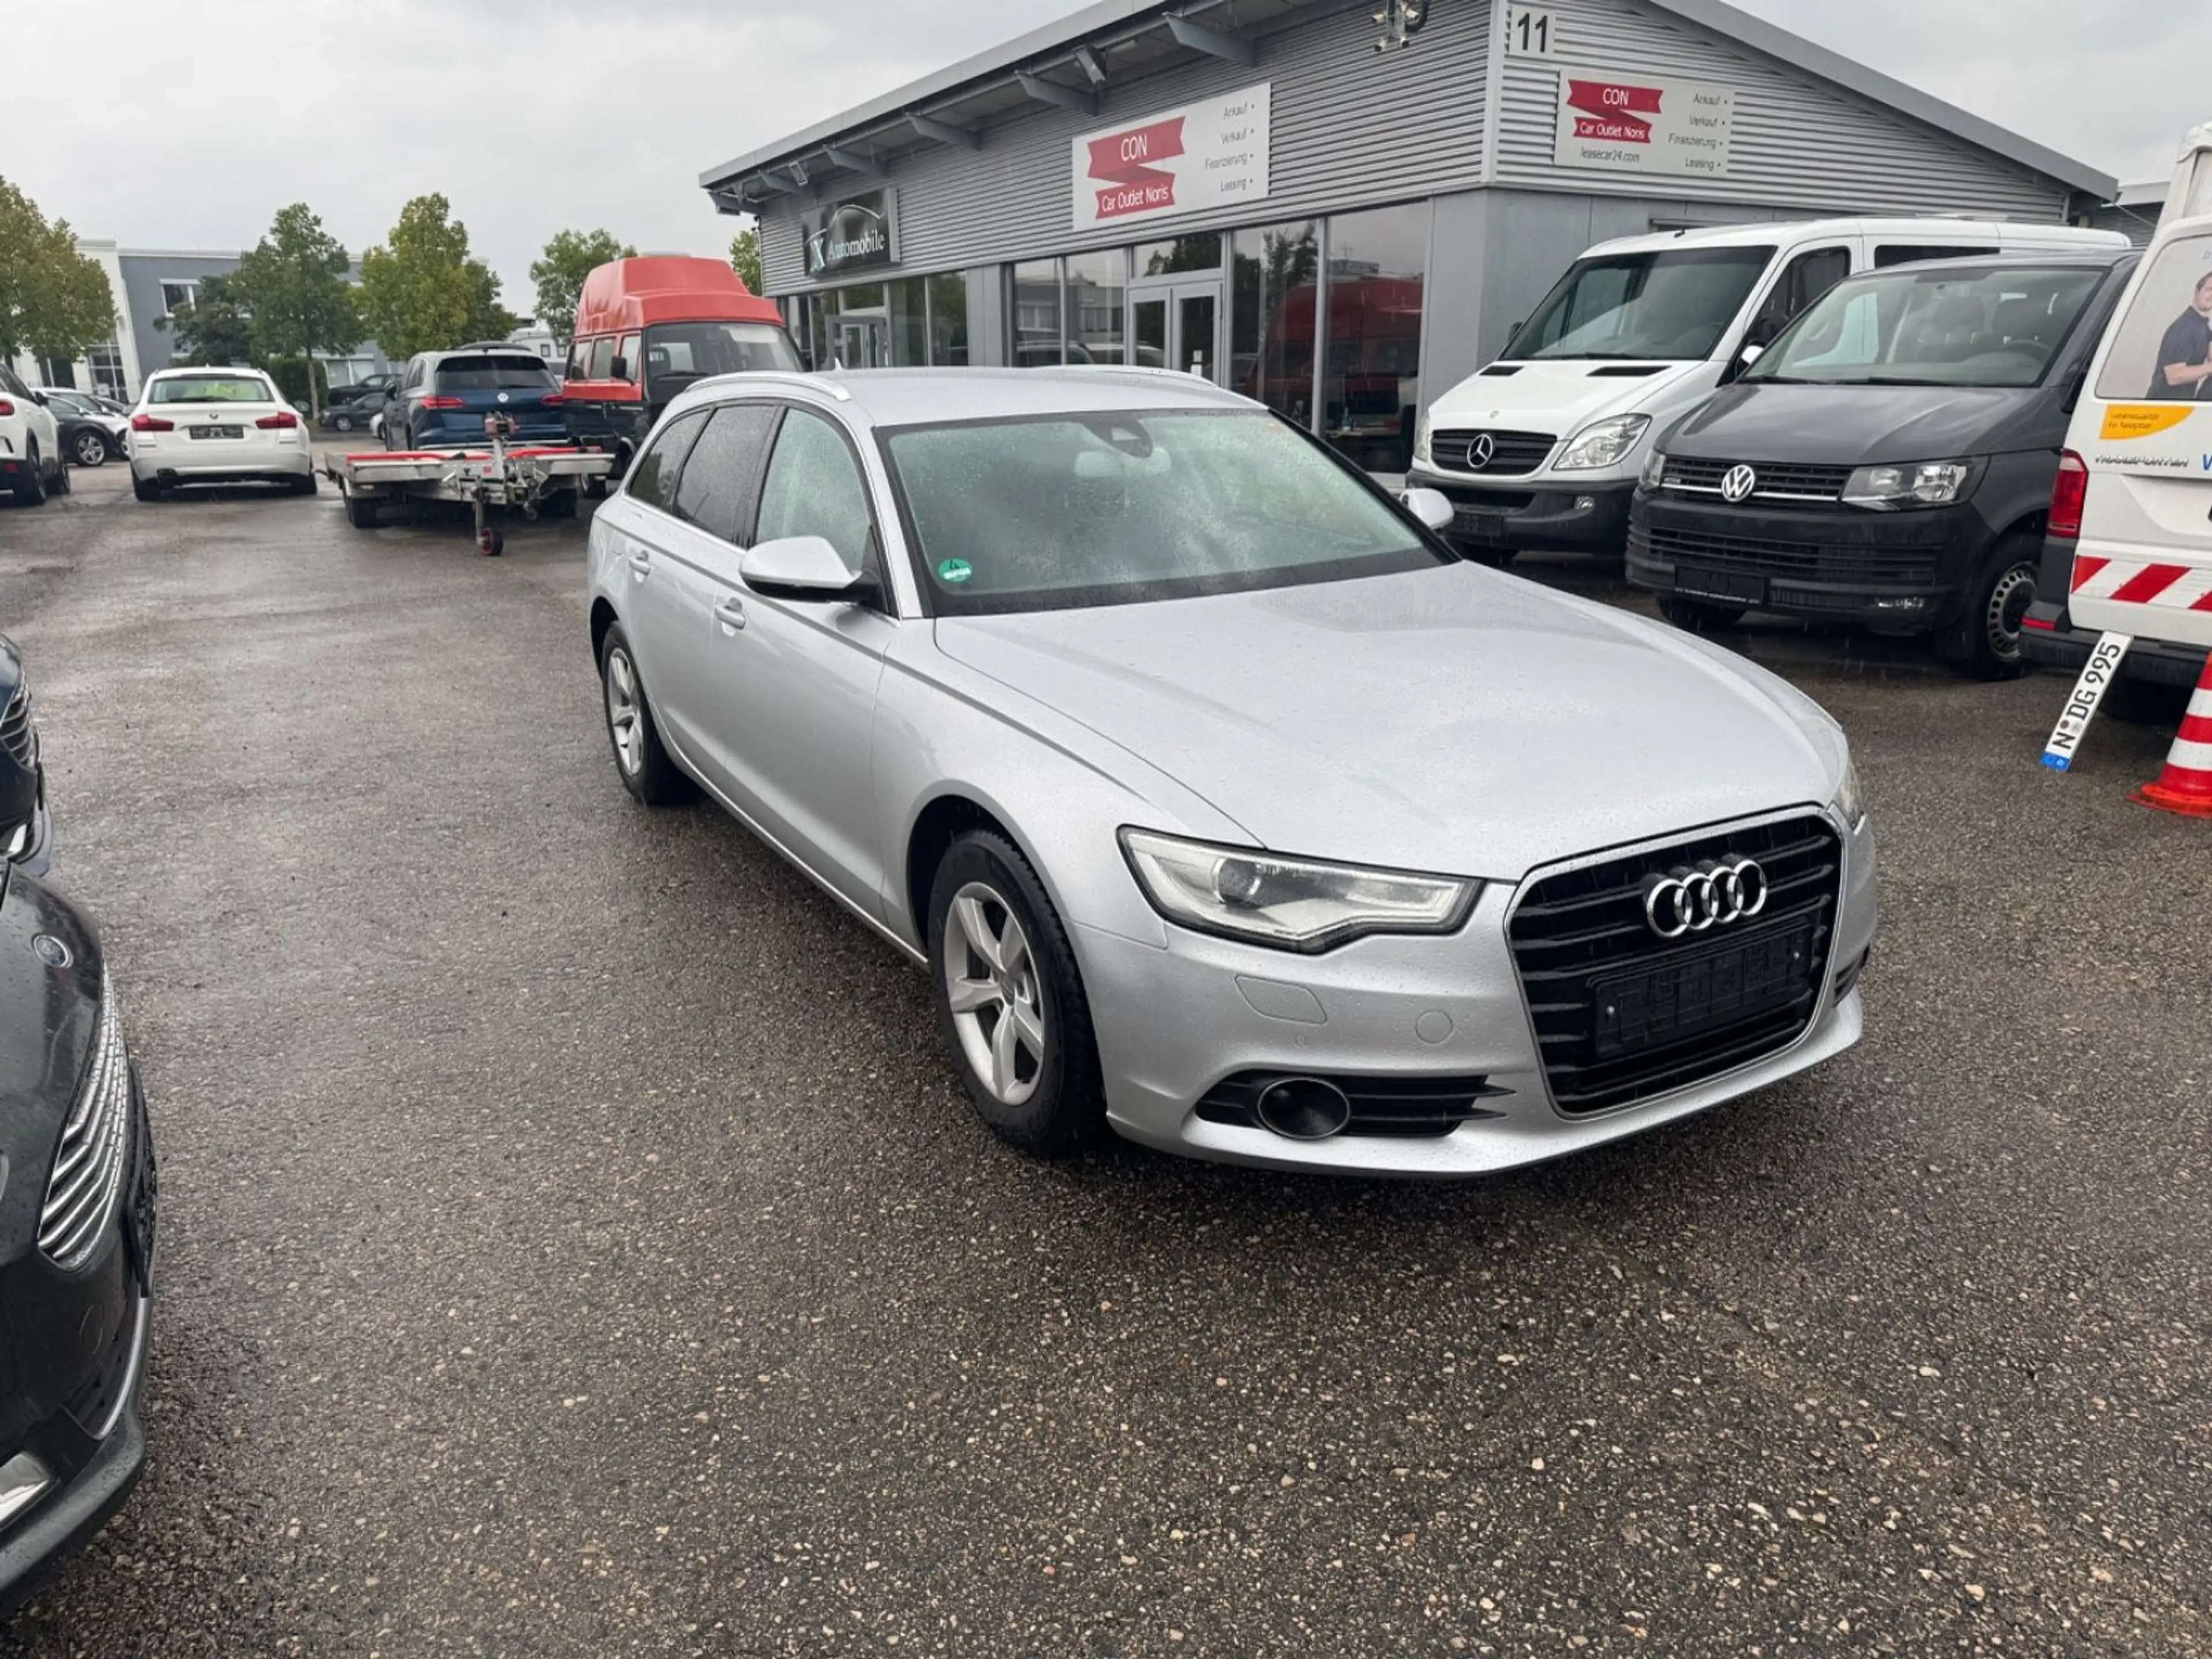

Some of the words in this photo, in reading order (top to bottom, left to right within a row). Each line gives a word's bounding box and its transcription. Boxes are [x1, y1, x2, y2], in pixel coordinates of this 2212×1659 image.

[1517, 12, 1548, 53] 11
[1603, 88, 1630, 106] CON
[1693, 93, 1721, 105] Ankauf
[1224, 101, 1248, 120] Ankauf
[1580, 121, 1595, 134] Car
[1596, 123, 1622, 138] Outlet
[1623, 126, 1646, 139] Noris
[1690, 115, 1718, 127] Verkauf
[1221, 127, 1247, 144] Verkauf
[1121, 133, 1147, 161] CON
[1685, 157, 1714, 172] Leasing
[1221, 178, 1247, 192] Leasing
[1101, 194, 1116, 212] Car
[1118, 188, 1145, 209] Outlet
[1146, 183, 1169, 204] Noris
[827, 229, 885, 260] Automobile
[2085, 641, 2121, 684] 995
